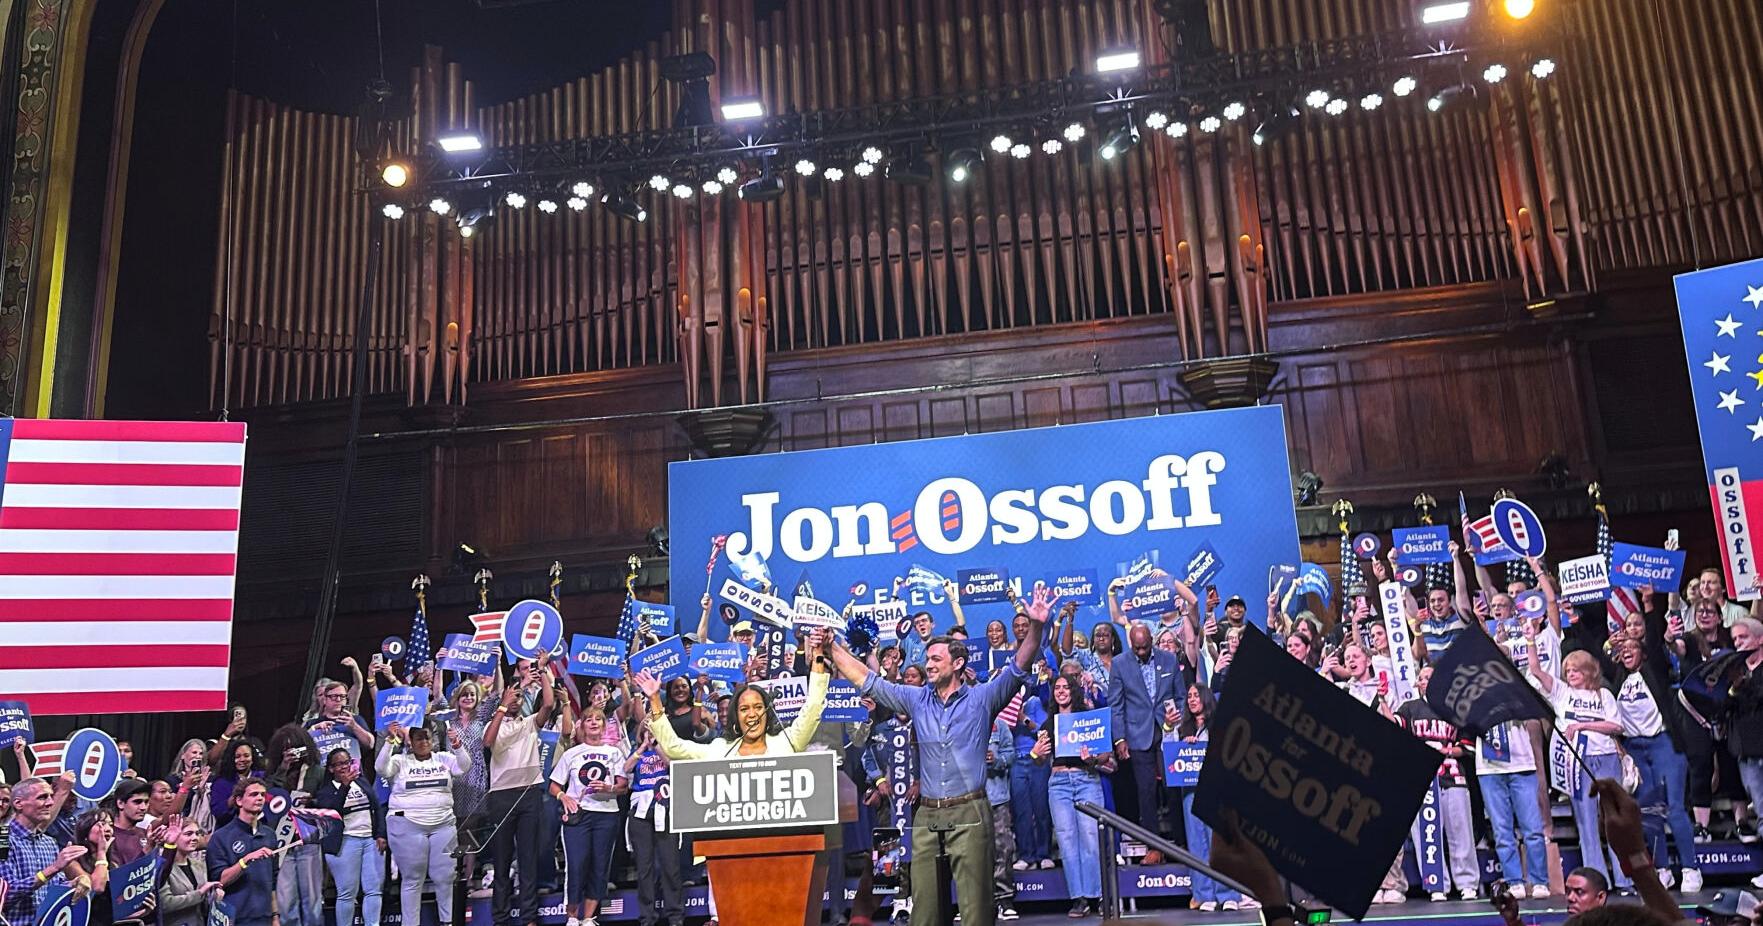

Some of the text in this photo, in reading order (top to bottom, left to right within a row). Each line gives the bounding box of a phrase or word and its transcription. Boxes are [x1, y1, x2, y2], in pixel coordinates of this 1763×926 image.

[726, 450, 1226, 562] Jon Ossoff
[1406, 533, 1436, 541] Atlanta
[1402, 539, 1443, 554] Ossoff
[1630, 552, 1670, 565] Atlanta
[970, 573, 998, 581] Atlanta
[1561, 563, 1604, 583] KEISHA
[1622, 561, 1675, 580] Ossoff
[1057, 575, 1086, 584] Atlanta
[965, 580, 1004, 595] Ossoff
[1054, 583, 1092, 597] Ossoff
[1135, 583, 1164, 594] Atlanta
[1131, 589, 1170, 608] Ossoff
[1569, 590, 1603, 603] GOVERNOR
[640, 607, 665, 616] Atlanta
[455, 640, 488, 651] Atlanta
[585, 642, 616, 652] Atlanta
[704, 648, 737, 656] Atlanta
[448, 648, 491, 664] Ossoff
[578, 651, 620, 666] Ossoff
[642, 647, 672, 665] Atlanta
[697, 656, 743, 669] Ossoff
[386, 693, 415, 702] Atlanta
[381, 703, 418, 718] Ossoff
[1072, 717, 1101, 728] Atlanta
[1253, 681, 1374, 777] Atlanta
[313, 731, 345, 742] Atlanta
[1067, 726, 1105, 743] Ossoff
[582, 752, 609, 760] VOTE
[693, 768, 815, 805] UNITED
[1221, 716, 1382, 846] Ossoff
[716, 800, 807, 823] GEORGIA
[1137, 874, 1163, 888] Jon
